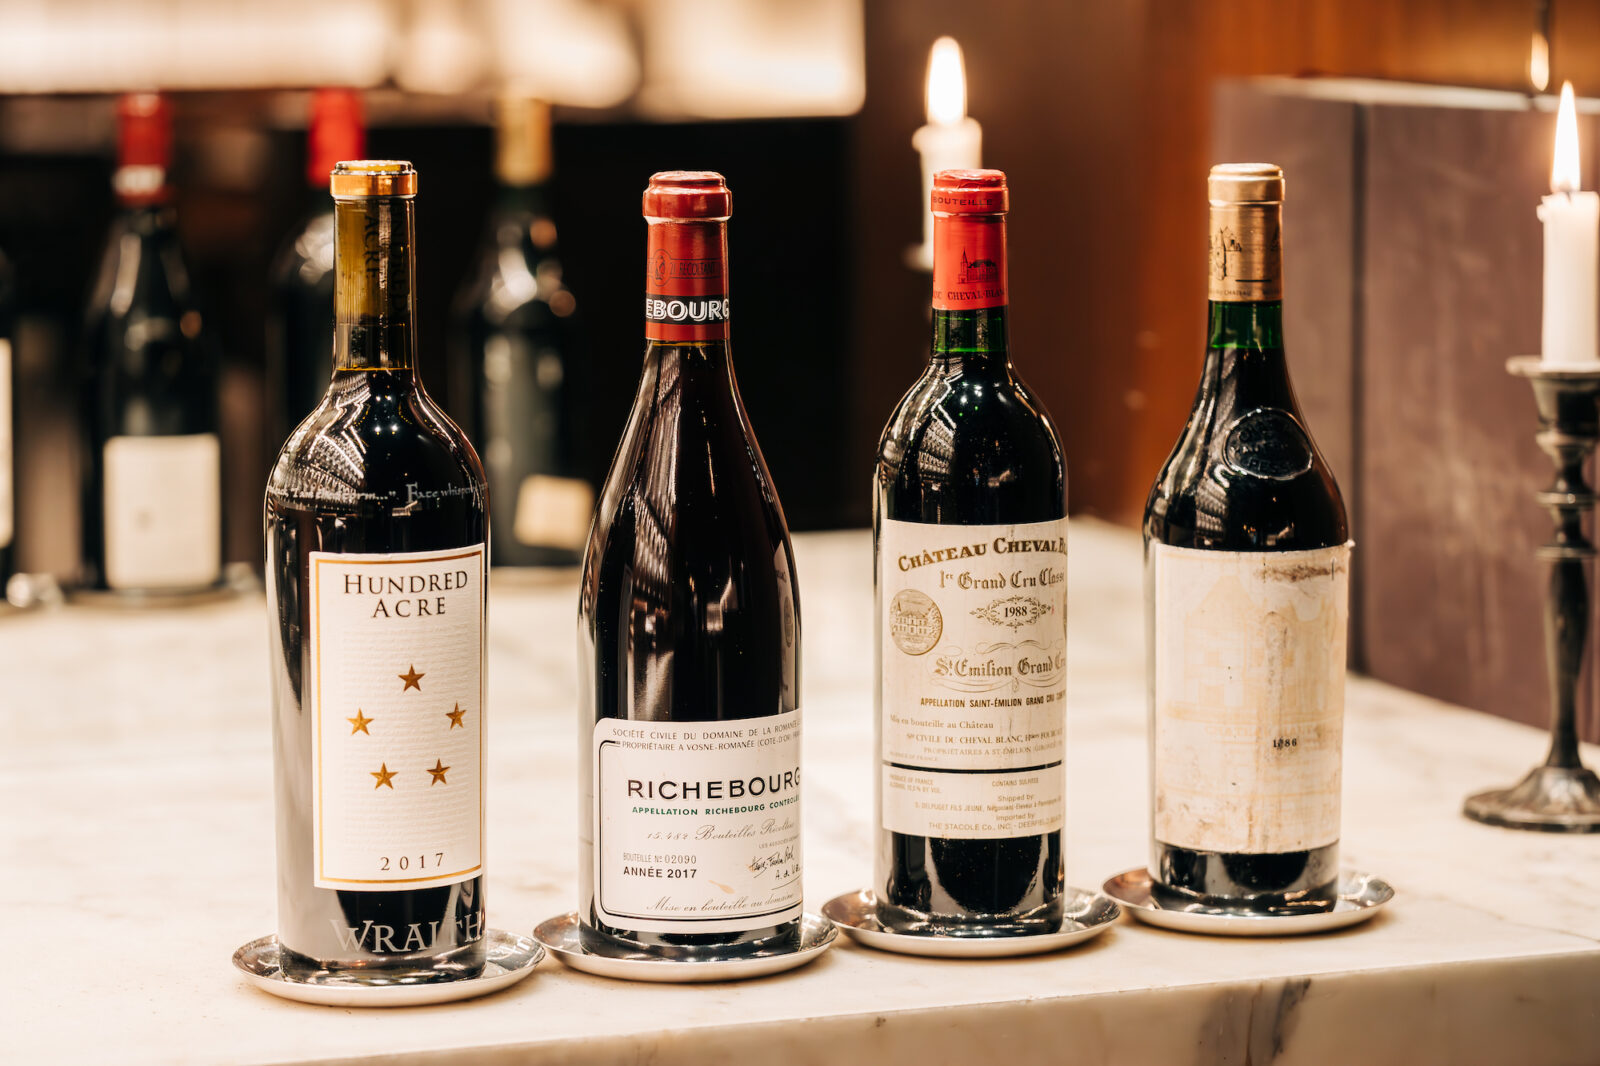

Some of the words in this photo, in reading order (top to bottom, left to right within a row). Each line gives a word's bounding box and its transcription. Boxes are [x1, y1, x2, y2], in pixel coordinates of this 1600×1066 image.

[898, 542, 988, 572] CHÂTEAU
[993, 537, 1058, 554] CHEVAL
[343, 570, 468, 594] HUNDRED
[957, 571, 1007, 590] Grand
[1011, 570, 1037, 588] Cru
[372, 597, 447, 618] ACRE
[1004, 606, 1028, 618] 1988
[1017, 656, 1053, 675] Grand
[920, 697, 965, 708] APPELLATION
[970, 697, 1022, 708] SAINT-ÉMILION
[1025, 696, 1045, 706] GRAND
[910, 717, 944, 729] bouteille
[959, 720, 994, 730] Château
[650, 731, 678, 740] CIVILE
[683, 732, 697, 740] DU
[702, 729, 744, 740] DOMAINE
[748, 728, 758, 737] DE
[762, 726, 772, 736] LA
[916, 734, 941, 743] CIVILE
[960, 736, 992, 744] CHEVAL
[628, 766, 800, 800] RICHEBOURG
[632, 806, 698, 816] APPELLATION
[704, 803, 766, 816] RICHEBOURG
[380, 852, 444, 871] 2017
[622, 852, 652, 863] BOUTEILLE
[664, 854, 698, 864] 02090
[623, 866, 663, 878] ANNÉE
[667, 868, 698, 879] 2017
[683, 904, 697, 912] en
[700, 896, 747, 912] bouteille
